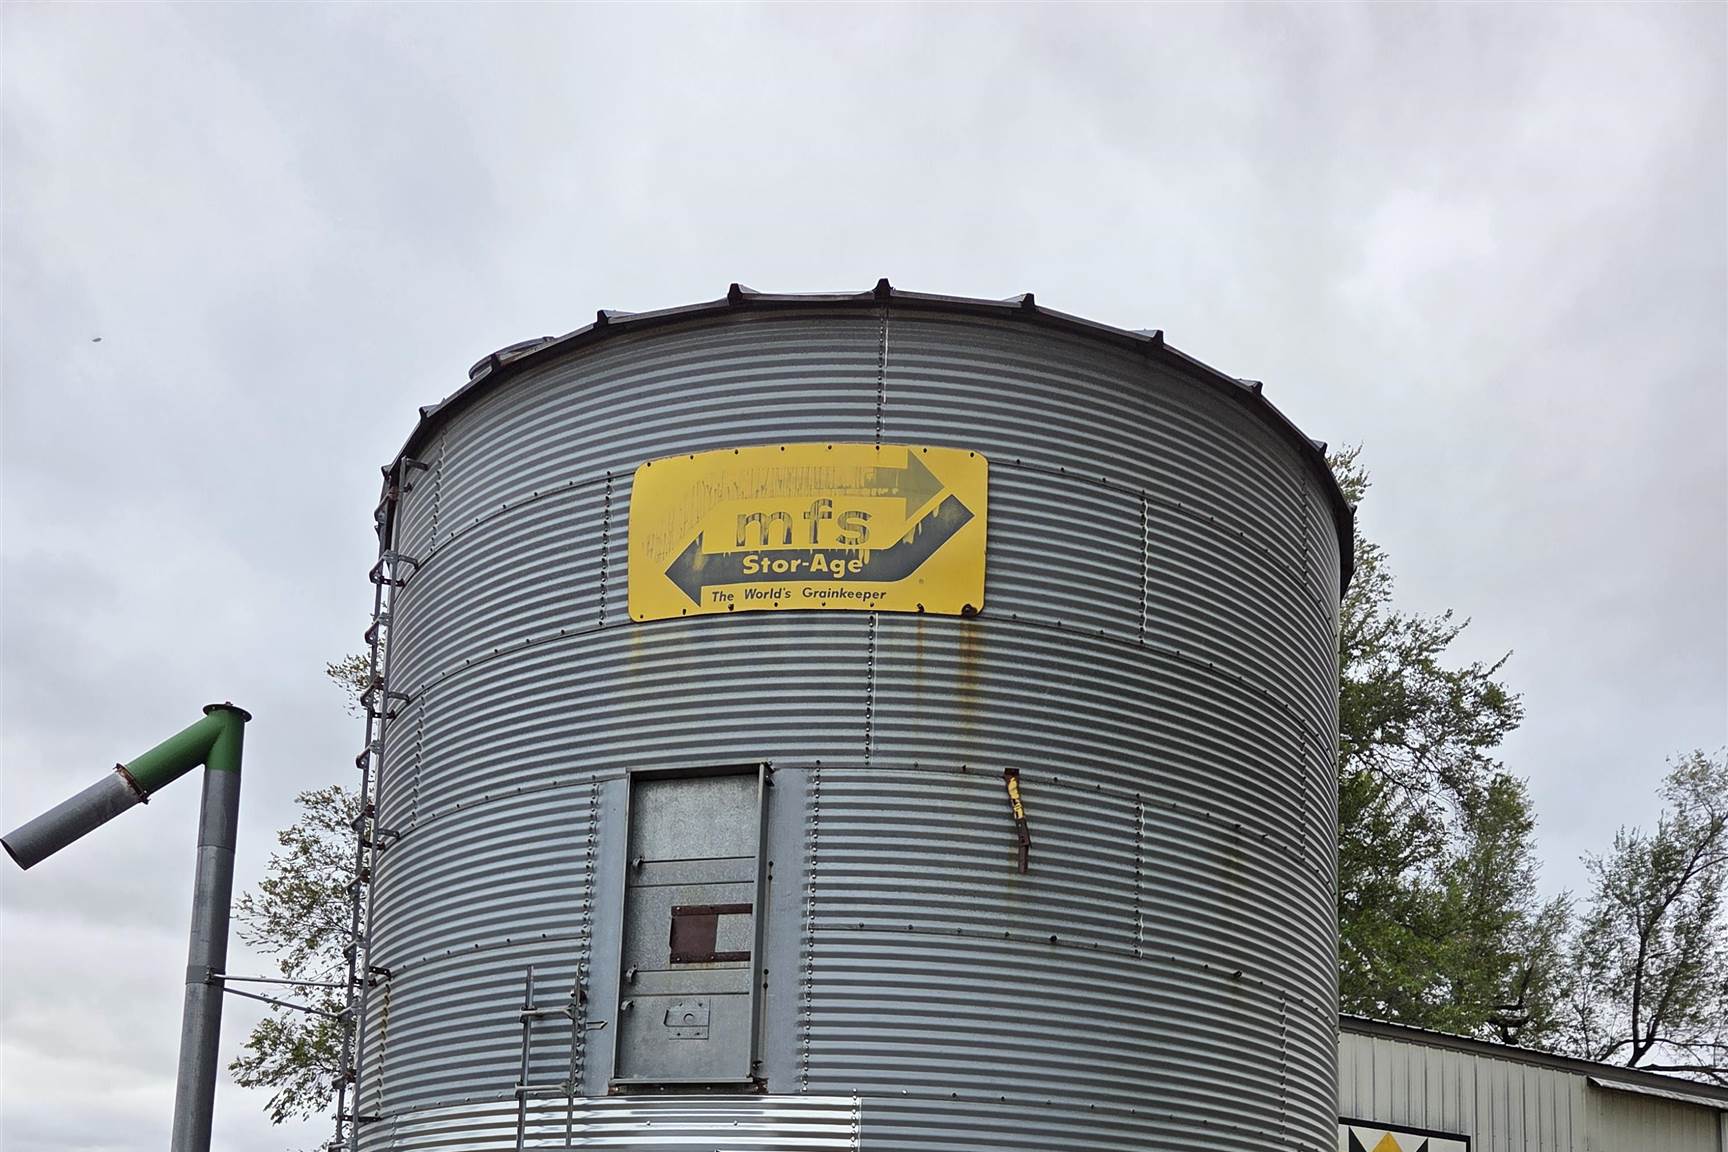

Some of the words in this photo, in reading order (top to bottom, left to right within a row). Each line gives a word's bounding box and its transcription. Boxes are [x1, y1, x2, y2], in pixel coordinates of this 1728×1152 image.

[736, 498, 873, 547] mfs
[742, 553, 863, 579] Stor-Age
[711, 590, 735, 602] The
[744, 586, 791, 600] World's
[801, 586, 887, 601] Grainkeeper
